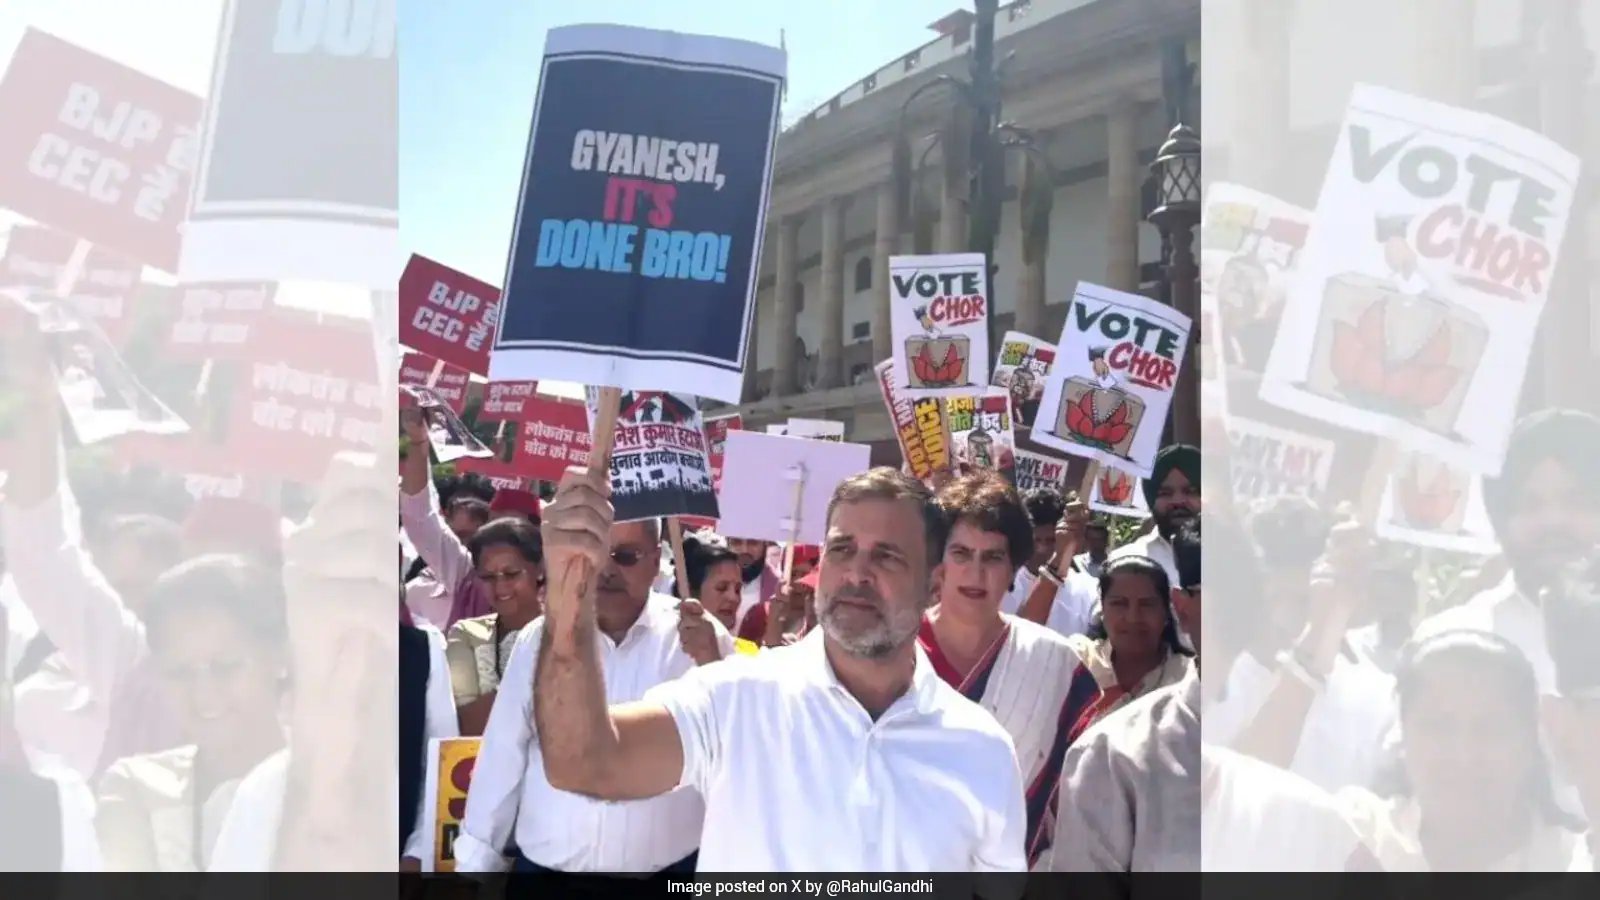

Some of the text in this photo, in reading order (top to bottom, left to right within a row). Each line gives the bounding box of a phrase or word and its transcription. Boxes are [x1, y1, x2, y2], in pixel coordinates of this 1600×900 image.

[59, 82, 162, 148] BJP
[29, 132, 128, 204] CEC
[570, 129, 726, 191] GYANESH,
[1348, 124, 1557, 238] VOTE
[603, 176, 677, 228] IT'S
[535, 218, 732, 284] DONE BRO!
[1416, 204, 1551, 295] CHOR
[428, 280, 480, 315] BJP
[893, 269, 980, 298] VOTE
[930, 295, 986, 322] CHOR
[412, 306, 463, 343] CEC
[1074, 302, 1179, 360] VOTE
[1109, 341, 1177, 388] CHOR
[641, 424, 677, 449] कुमार
[644, 447, 678, 466] आयोग
[913, 397, 949, 470] VOICE
[1041, 461, 1063, 480] MY
